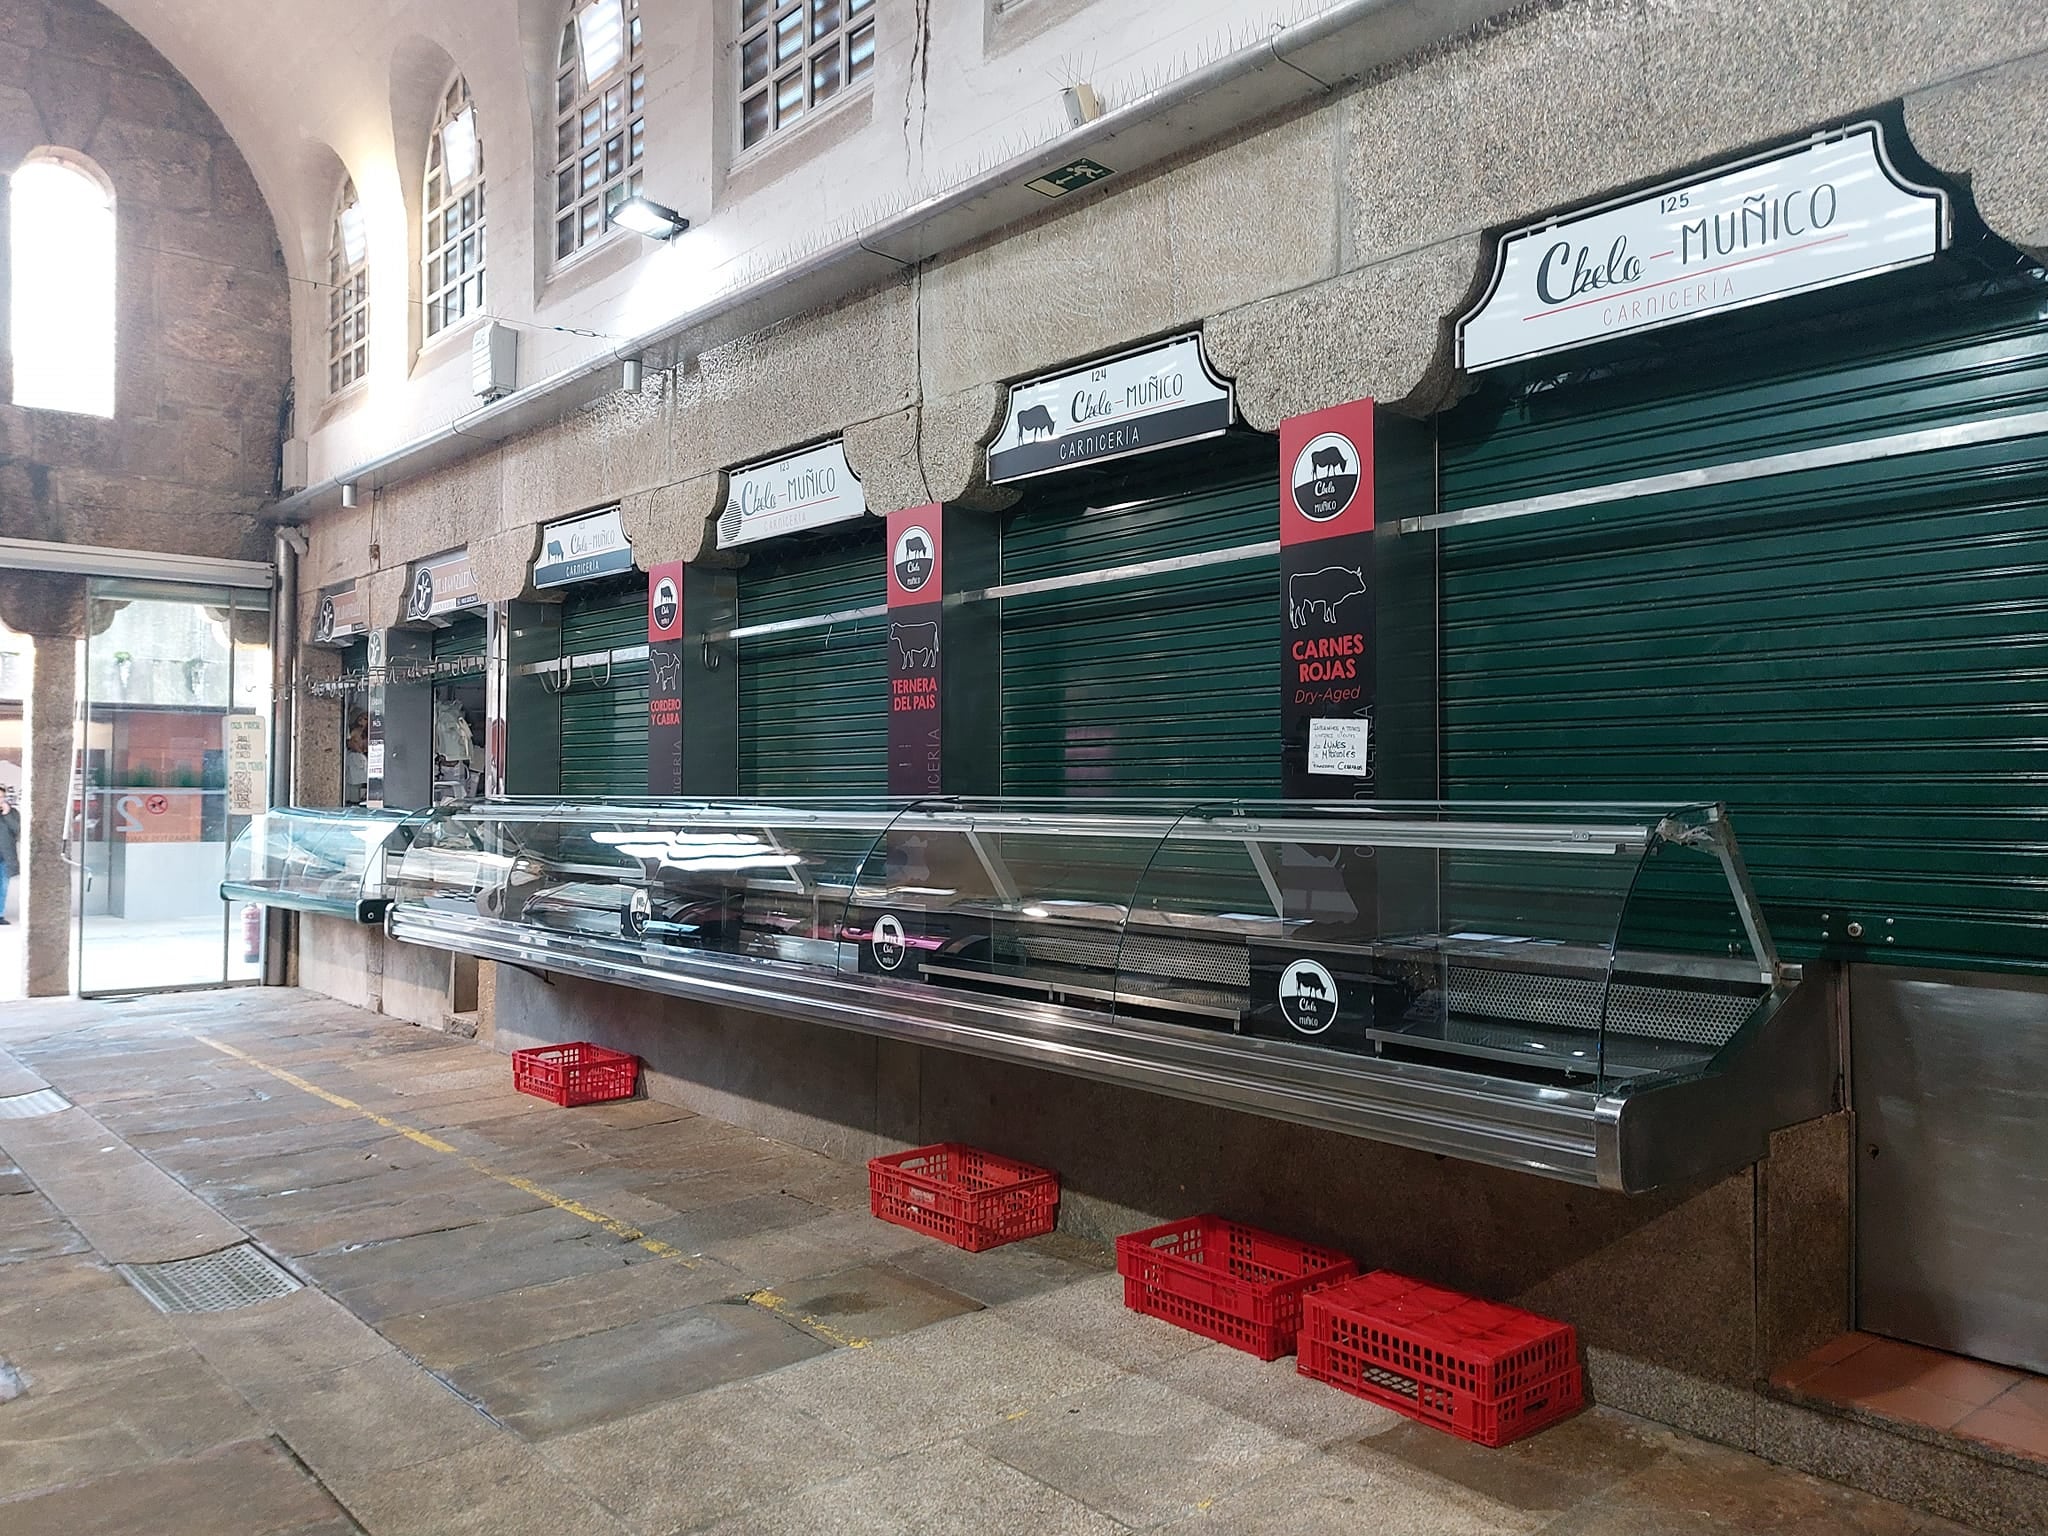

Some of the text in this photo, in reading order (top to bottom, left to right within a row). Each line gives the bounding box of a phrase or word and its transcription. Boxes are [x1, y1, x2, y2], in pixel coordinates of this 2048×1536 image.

[1660, 193, 1690, 214] 125
[1536, 183, 1838, 304] Chelo MUÑICO
[1603, 277, 1735, 326] CARNICERÍA
[1091, 368, 1107, 382] 124
[1071, 373, 1183, 423] Chelo MUÑICO
[1059, 426, 1140, 460] CARNICERÍA
[779, 462, 790, 473] 123
[741, 467, 836, 516] Chelo MUÑICO
[1314, 480, 1336, 497] Chelo
[1291, 634, 1365, 661] CARNES
[1298, 658, 1357, 683] ROJAS
[892, 676, 938, 696] TERNERA
[1294, 685, 1361, 705] Dry-Aged
[650, 698, 681, 713] CORDERO
[894, 697, 911, 712] DEL
[651, 712, 681, 726] Y CABRA
